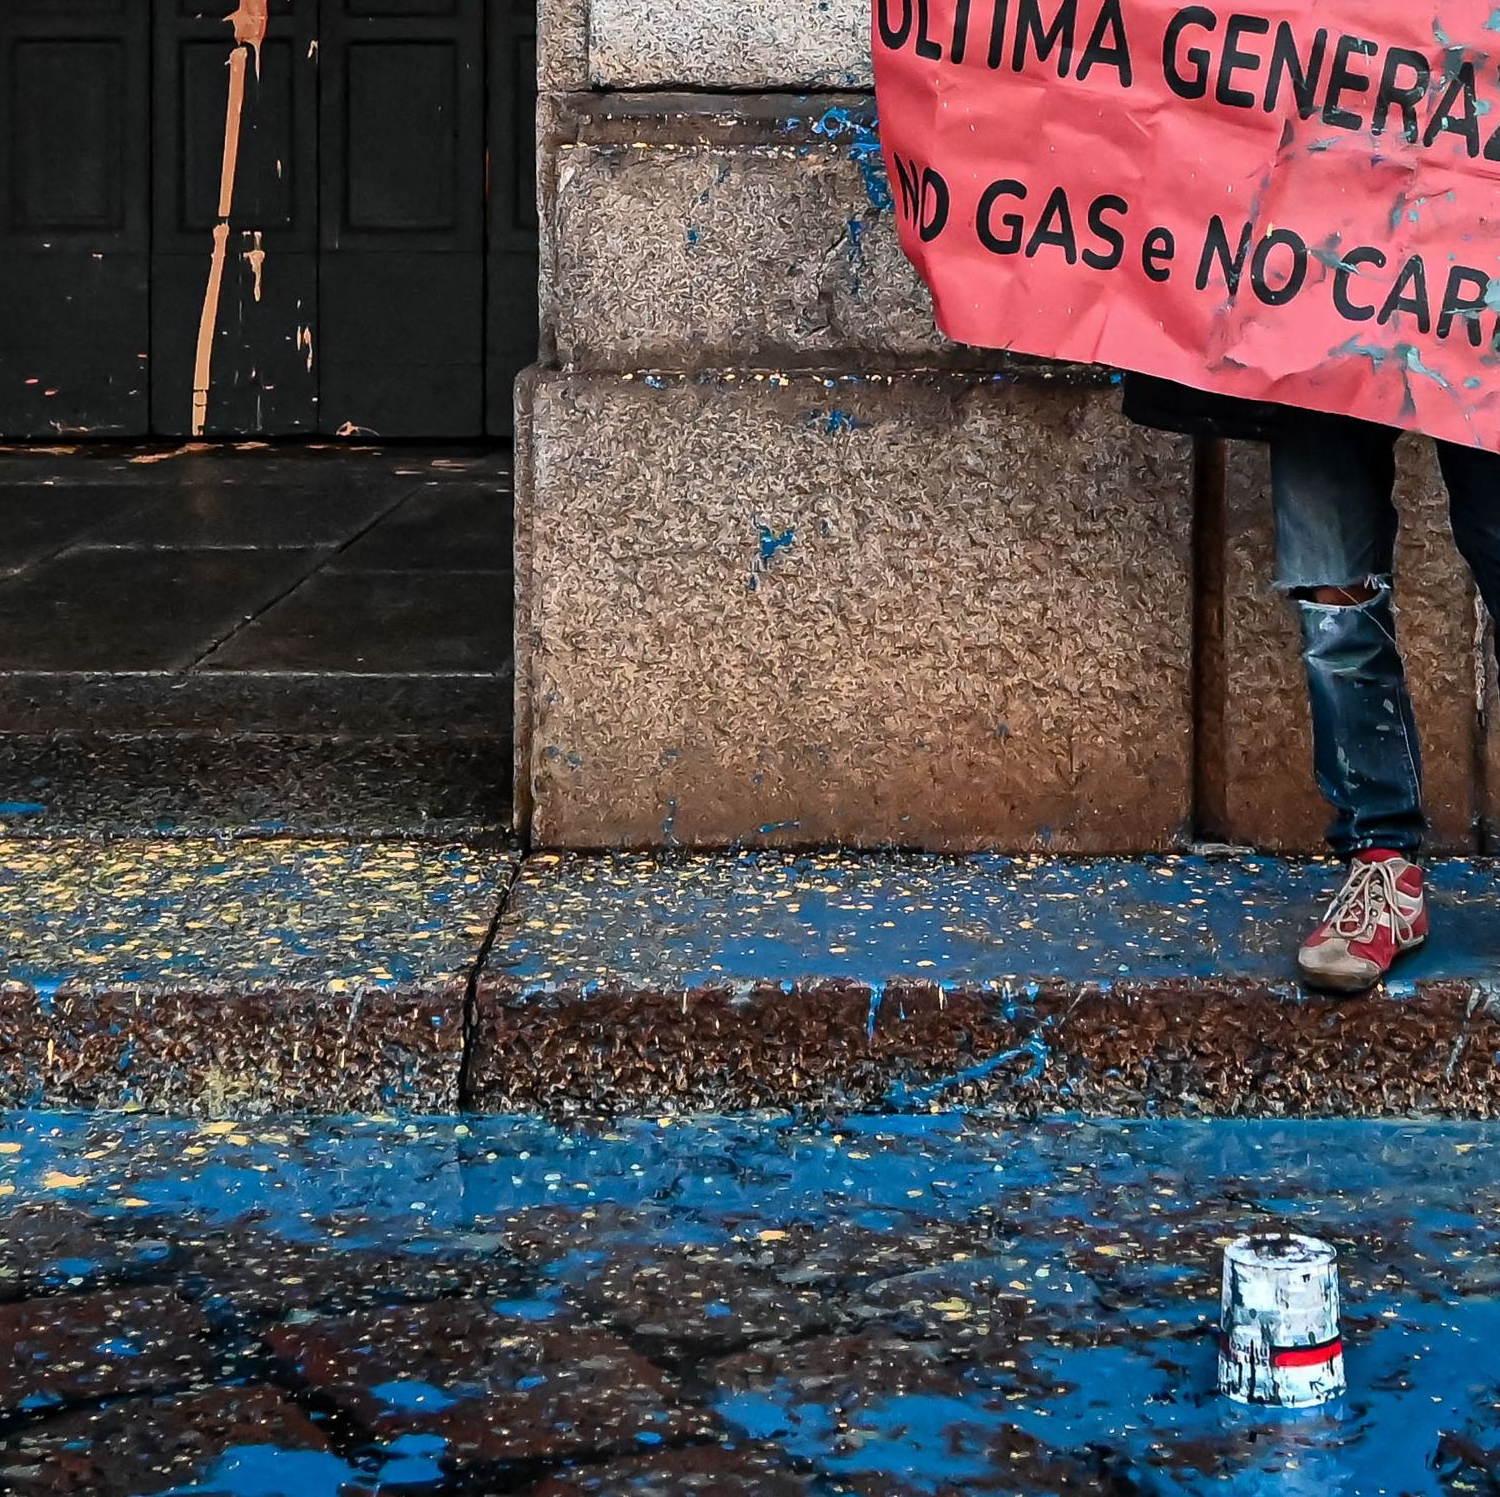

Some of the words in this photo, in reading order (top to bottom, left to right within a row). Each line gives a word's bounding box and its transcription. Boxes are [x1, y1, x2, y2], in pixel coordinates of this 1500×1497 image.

[892, 151, 950, 242] NO
[975, 179, 1129, 271] GAS
[1142, 226, 1175, 283] e
[1195, 214, 1308, 306] NO
